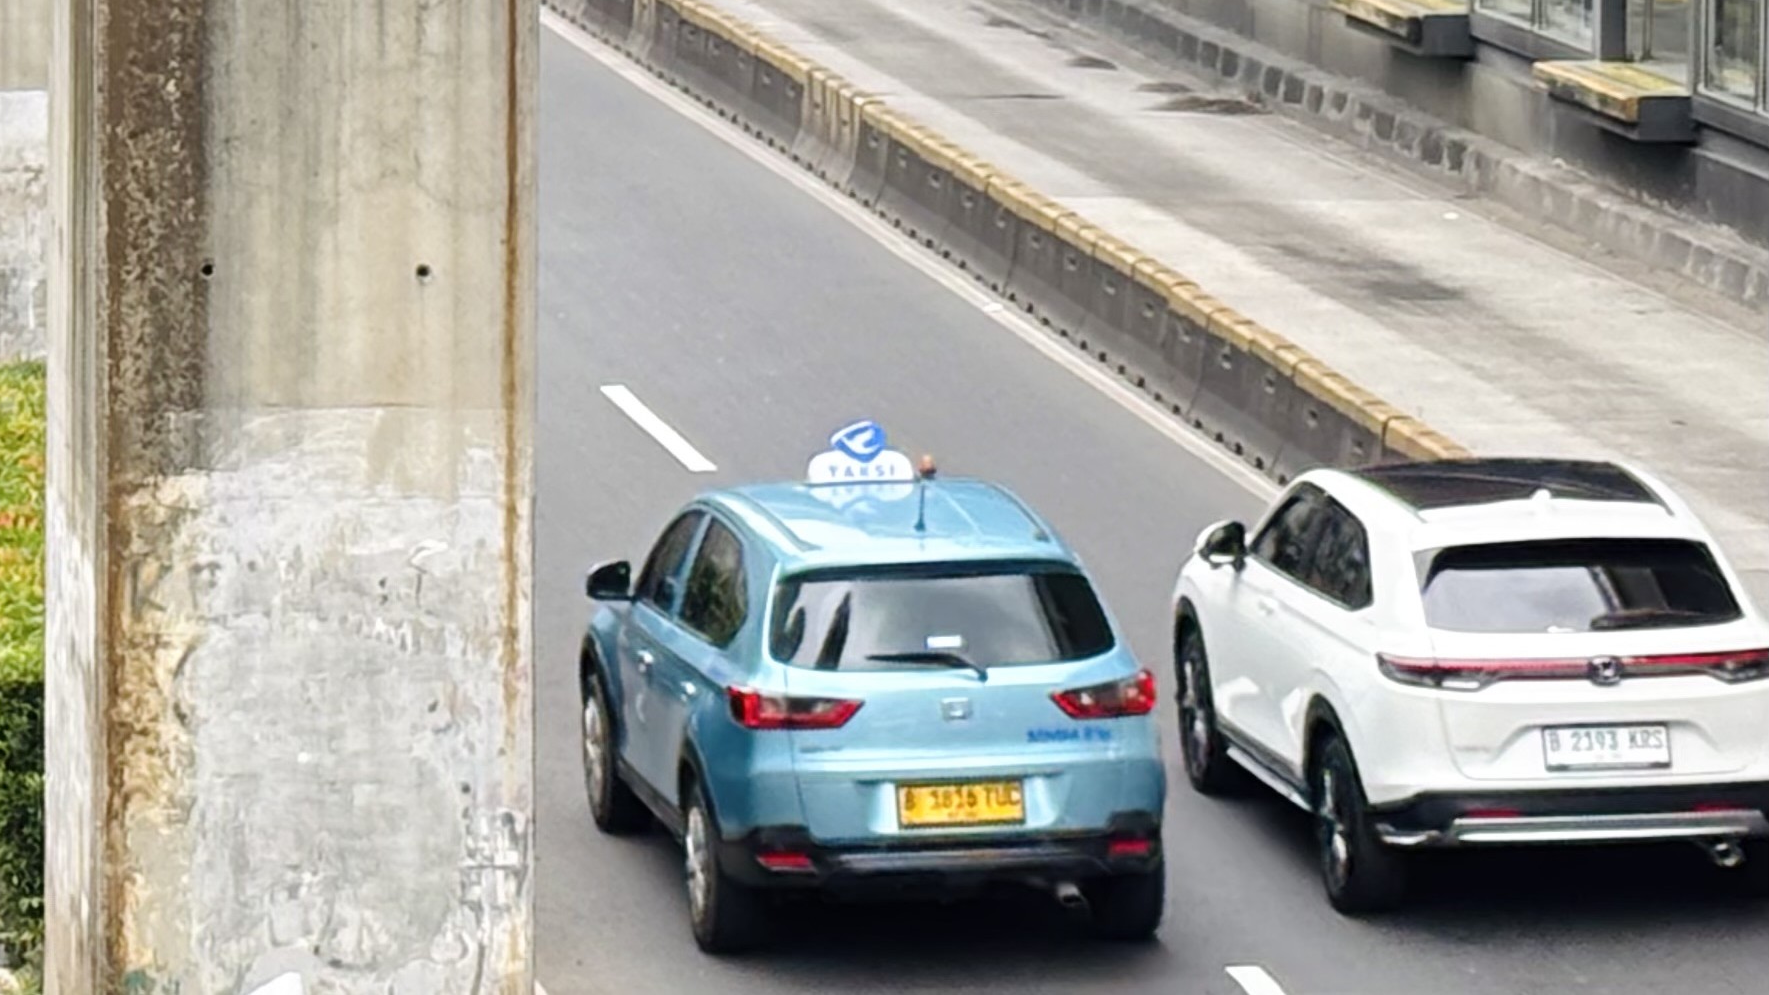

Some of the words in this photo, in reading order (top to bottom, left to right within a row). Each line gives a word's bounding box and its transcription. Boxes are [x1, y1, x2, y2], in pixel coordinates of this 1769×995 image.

[828, 464, 895, 478] TAKSI
[1548, 729, 1561, 752] B
[1570, 729, 1619, 752] 2193
[1628, 728, 1664, 749] KRS
[904, 787, 916, 811] B
